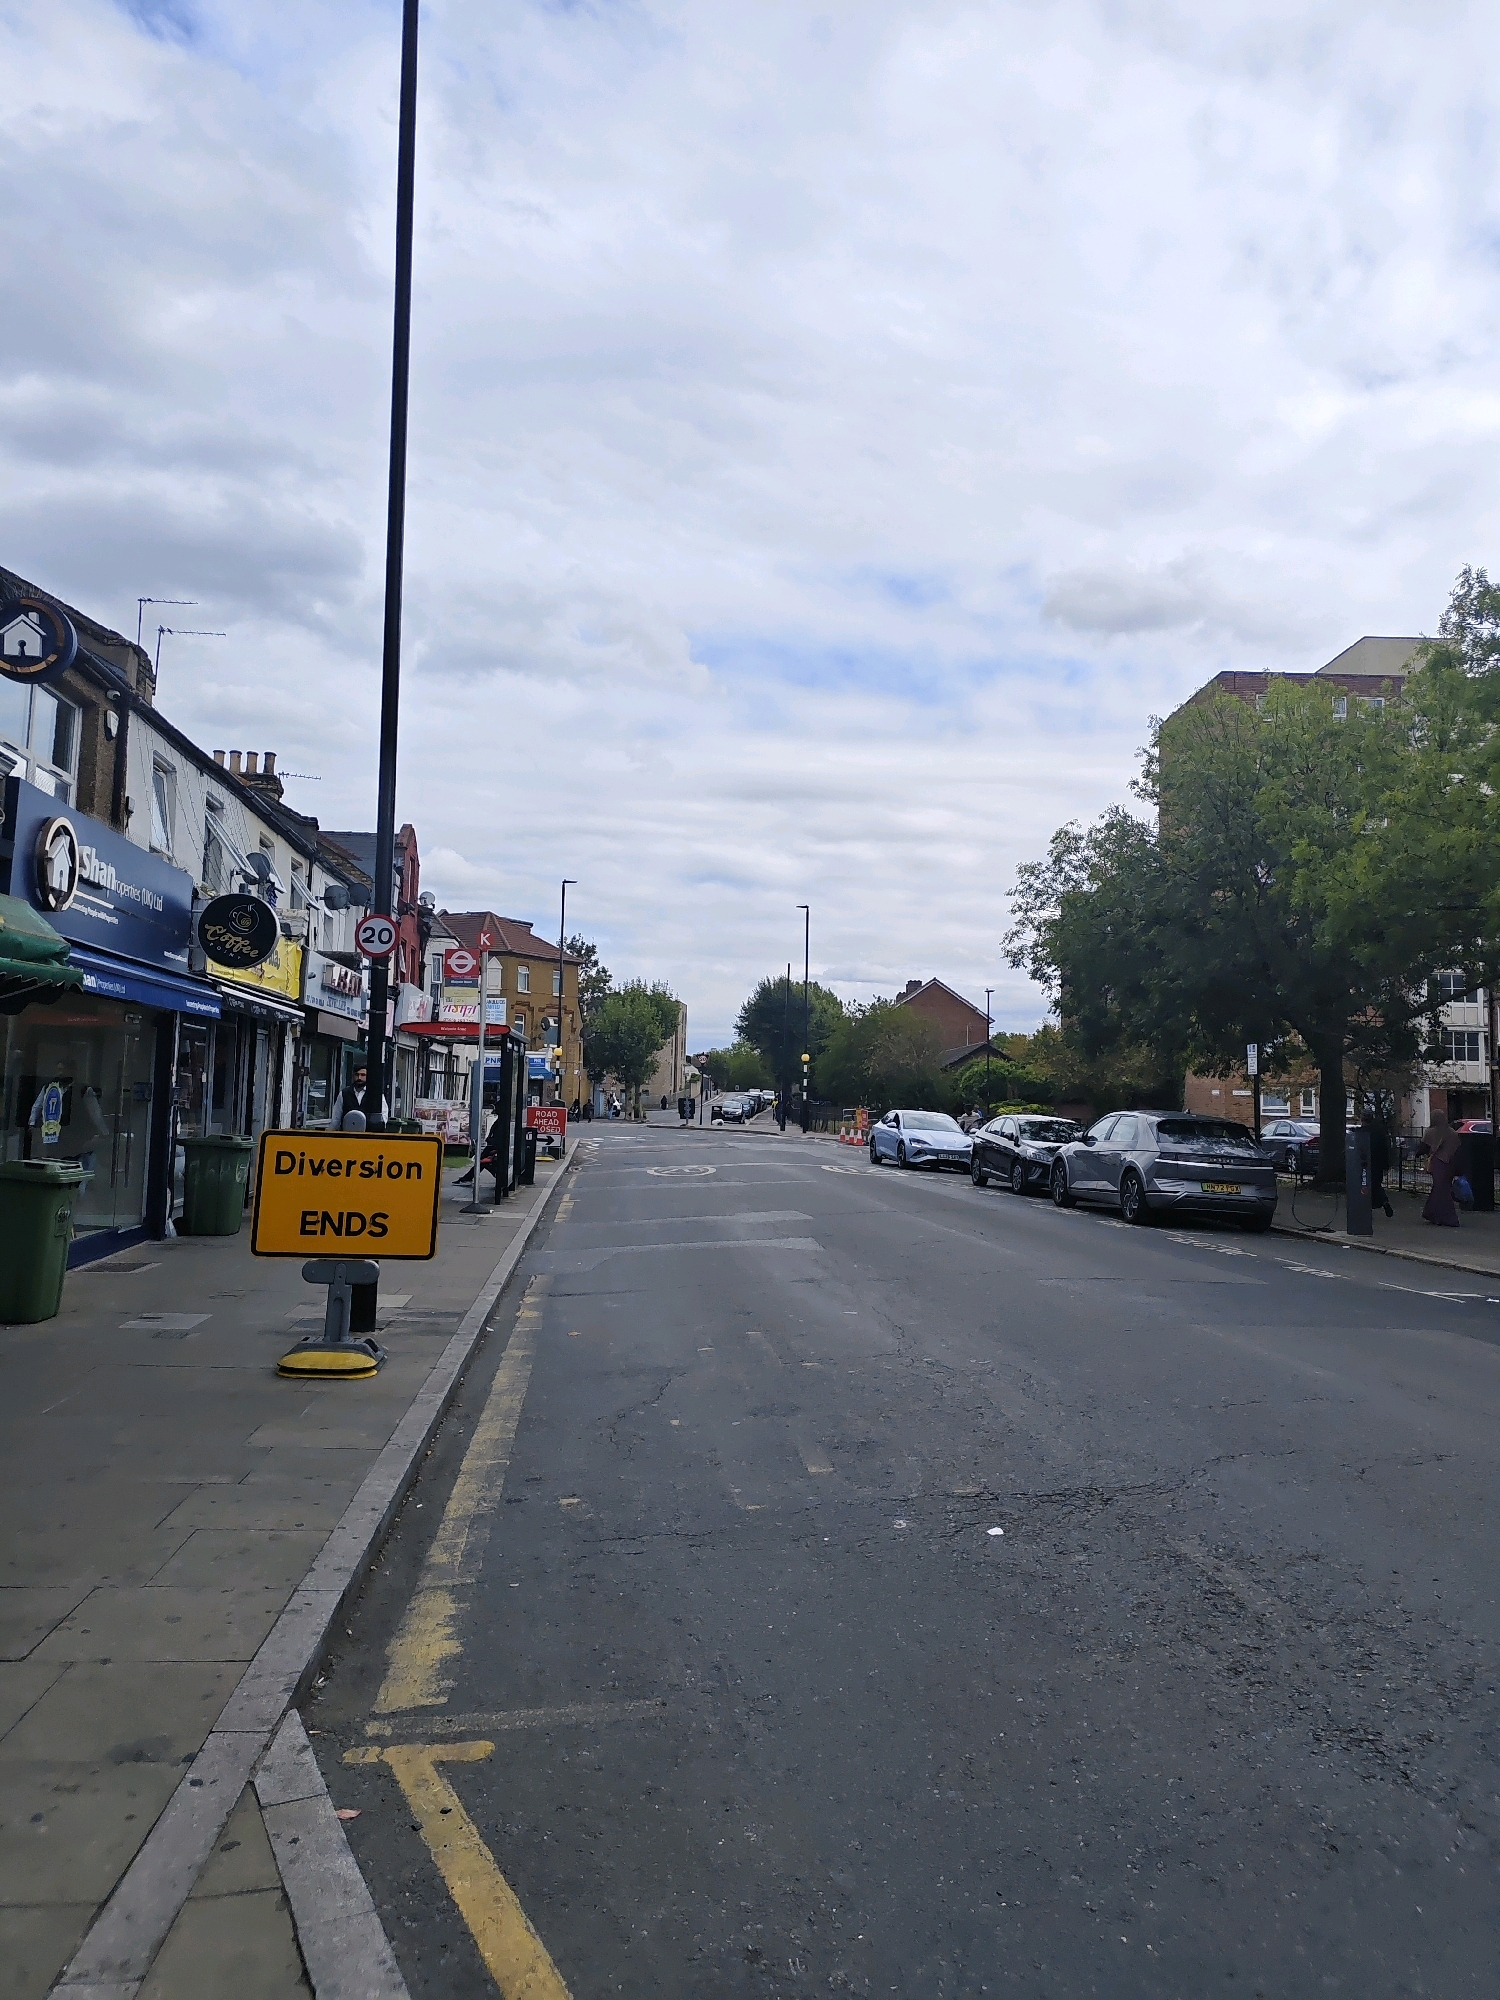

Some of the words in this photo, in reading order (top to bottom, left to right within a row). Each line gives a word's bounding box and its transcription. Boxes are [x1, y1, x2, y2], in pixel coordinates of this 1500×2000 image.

[81, 846, 116, 891] Shan
[153, 896, 164, 912] Ltd
[204, 923, 259, 958] Coffee
[361, 926, 393, 945] 20
[480, 933, 491, 946] K
[209, 942, 241, 960] POINT
[533, 1118, 559, 1126] AHEAD
[535, 1110, 558, 1118] ROAD
[274, 1150, 423, 1179] Diversion
[299, 1211, 390, 1238] ENDS
